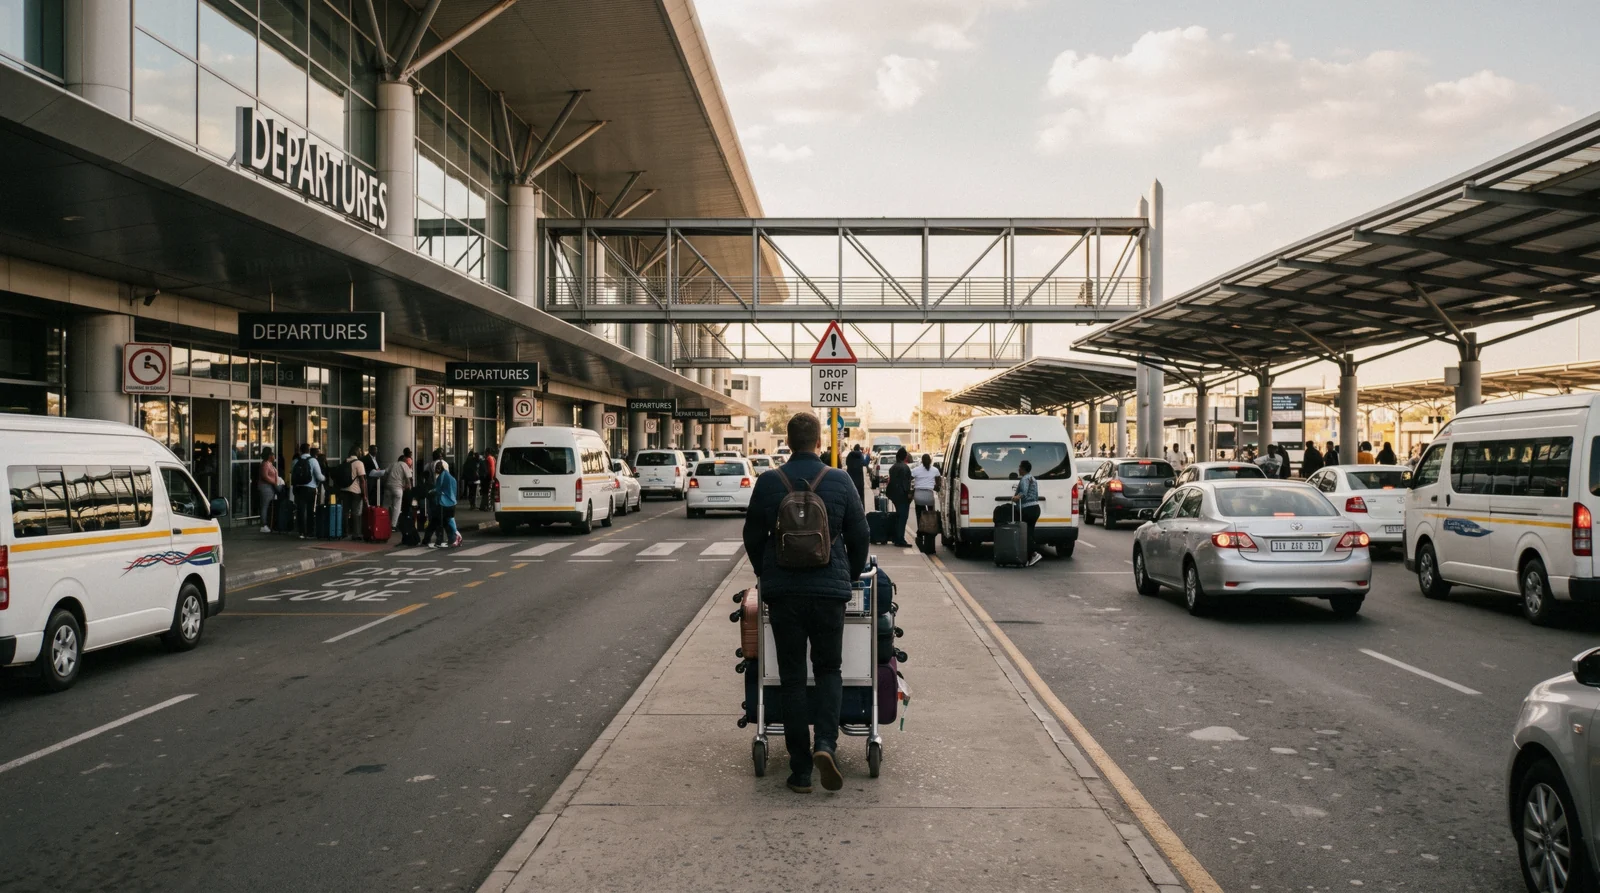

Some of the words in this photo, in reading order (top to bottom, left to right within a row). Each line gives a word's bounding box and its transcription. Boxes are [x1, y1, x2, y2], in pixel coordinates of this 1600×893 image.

[251, 107, 388, 230] DEPARTURES
[253, 323, 368, 340] DEPARTURES
[455, 369, 530, 380] DEPARTURES
[819, 369, 848, 379] DROP
[823, 381, 844, 391] OFF
[819, 393, 848, 402] ZONE
[343, 567, 472, 576] DROP
[321, 578, 431, 588] OFF
[247, 589, 411, 602] ZONE
